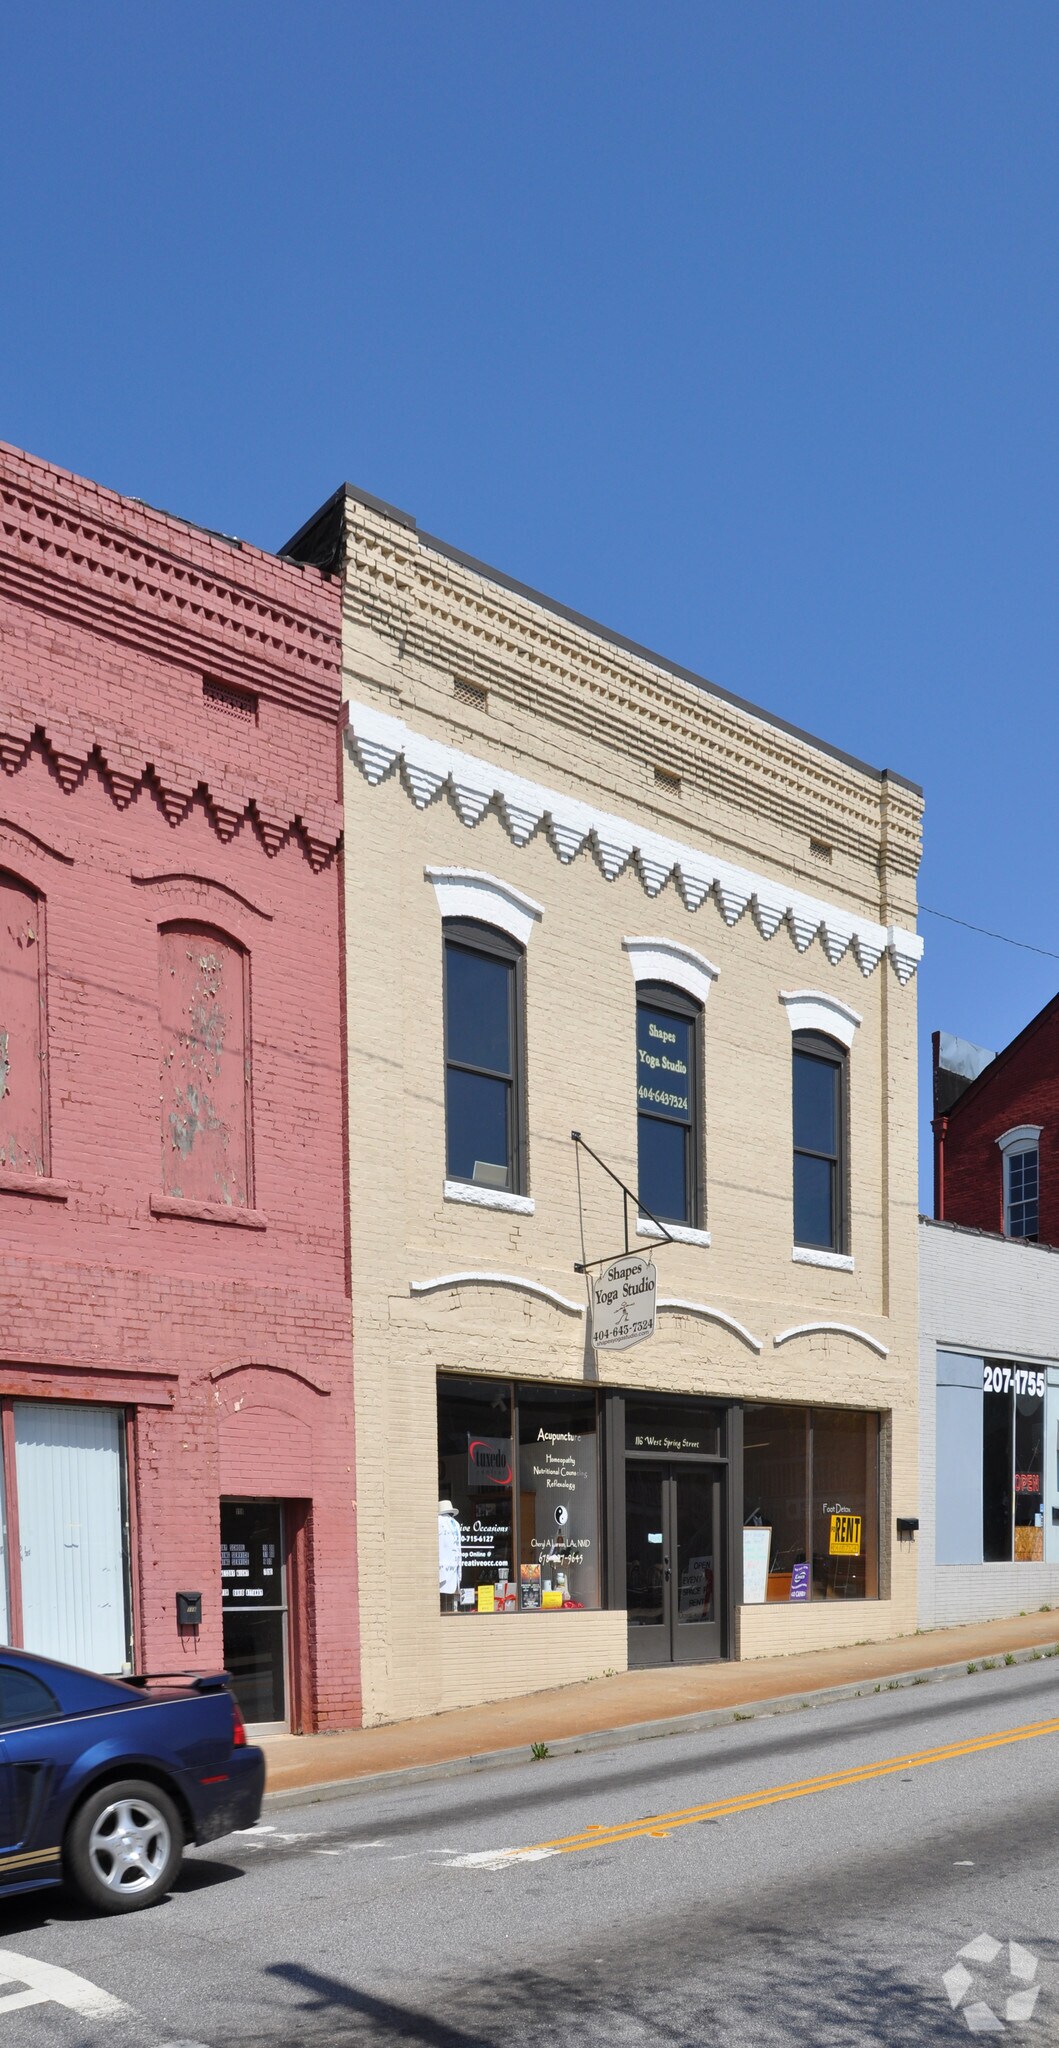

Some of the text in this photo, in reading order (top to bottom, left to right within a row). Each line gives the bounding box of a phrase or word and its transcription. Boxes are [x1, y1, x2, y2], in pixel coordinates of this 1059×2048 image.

[648, 1023, 676, 1043] Shapes
[638, 1049, 687, 1074] Yoga Studio
[638, 1085, 688, 1110] 404-643-7324
[607, 1263, 642, 1282] Shapes
[595, 1277, 655, 1305] Yoga Studio
[593, 1318, 653, 1342] 404-643-7324
[983, 1366, 1045, 1397] 207-1755
[537, 1427, 582, 1446] Acupuncture
[644, 1436, 662, 1446] West
[663, 1437, 681, 1450] Spring
[682, 1438, 700, 1449] Street
[475, 1449, 507, 1468] tuxedo
[545, 1454, 576, 1467] Homeopathy
[533, 1466, 560, 1476] Nutritional
[546, 1479, 576, 1491] Reflexology
[1014, 1473, 1041, 1492] OPEN
[822, 1503, 851, 1514] Foot Detox
[472, 1520, 509, 1533] Occasions
[834, 1517, 861, 1543] RENT
[461, 1535, 494, 1543] 0-715-6127
[461, 1559, 509, 1567] reativeocc.com
